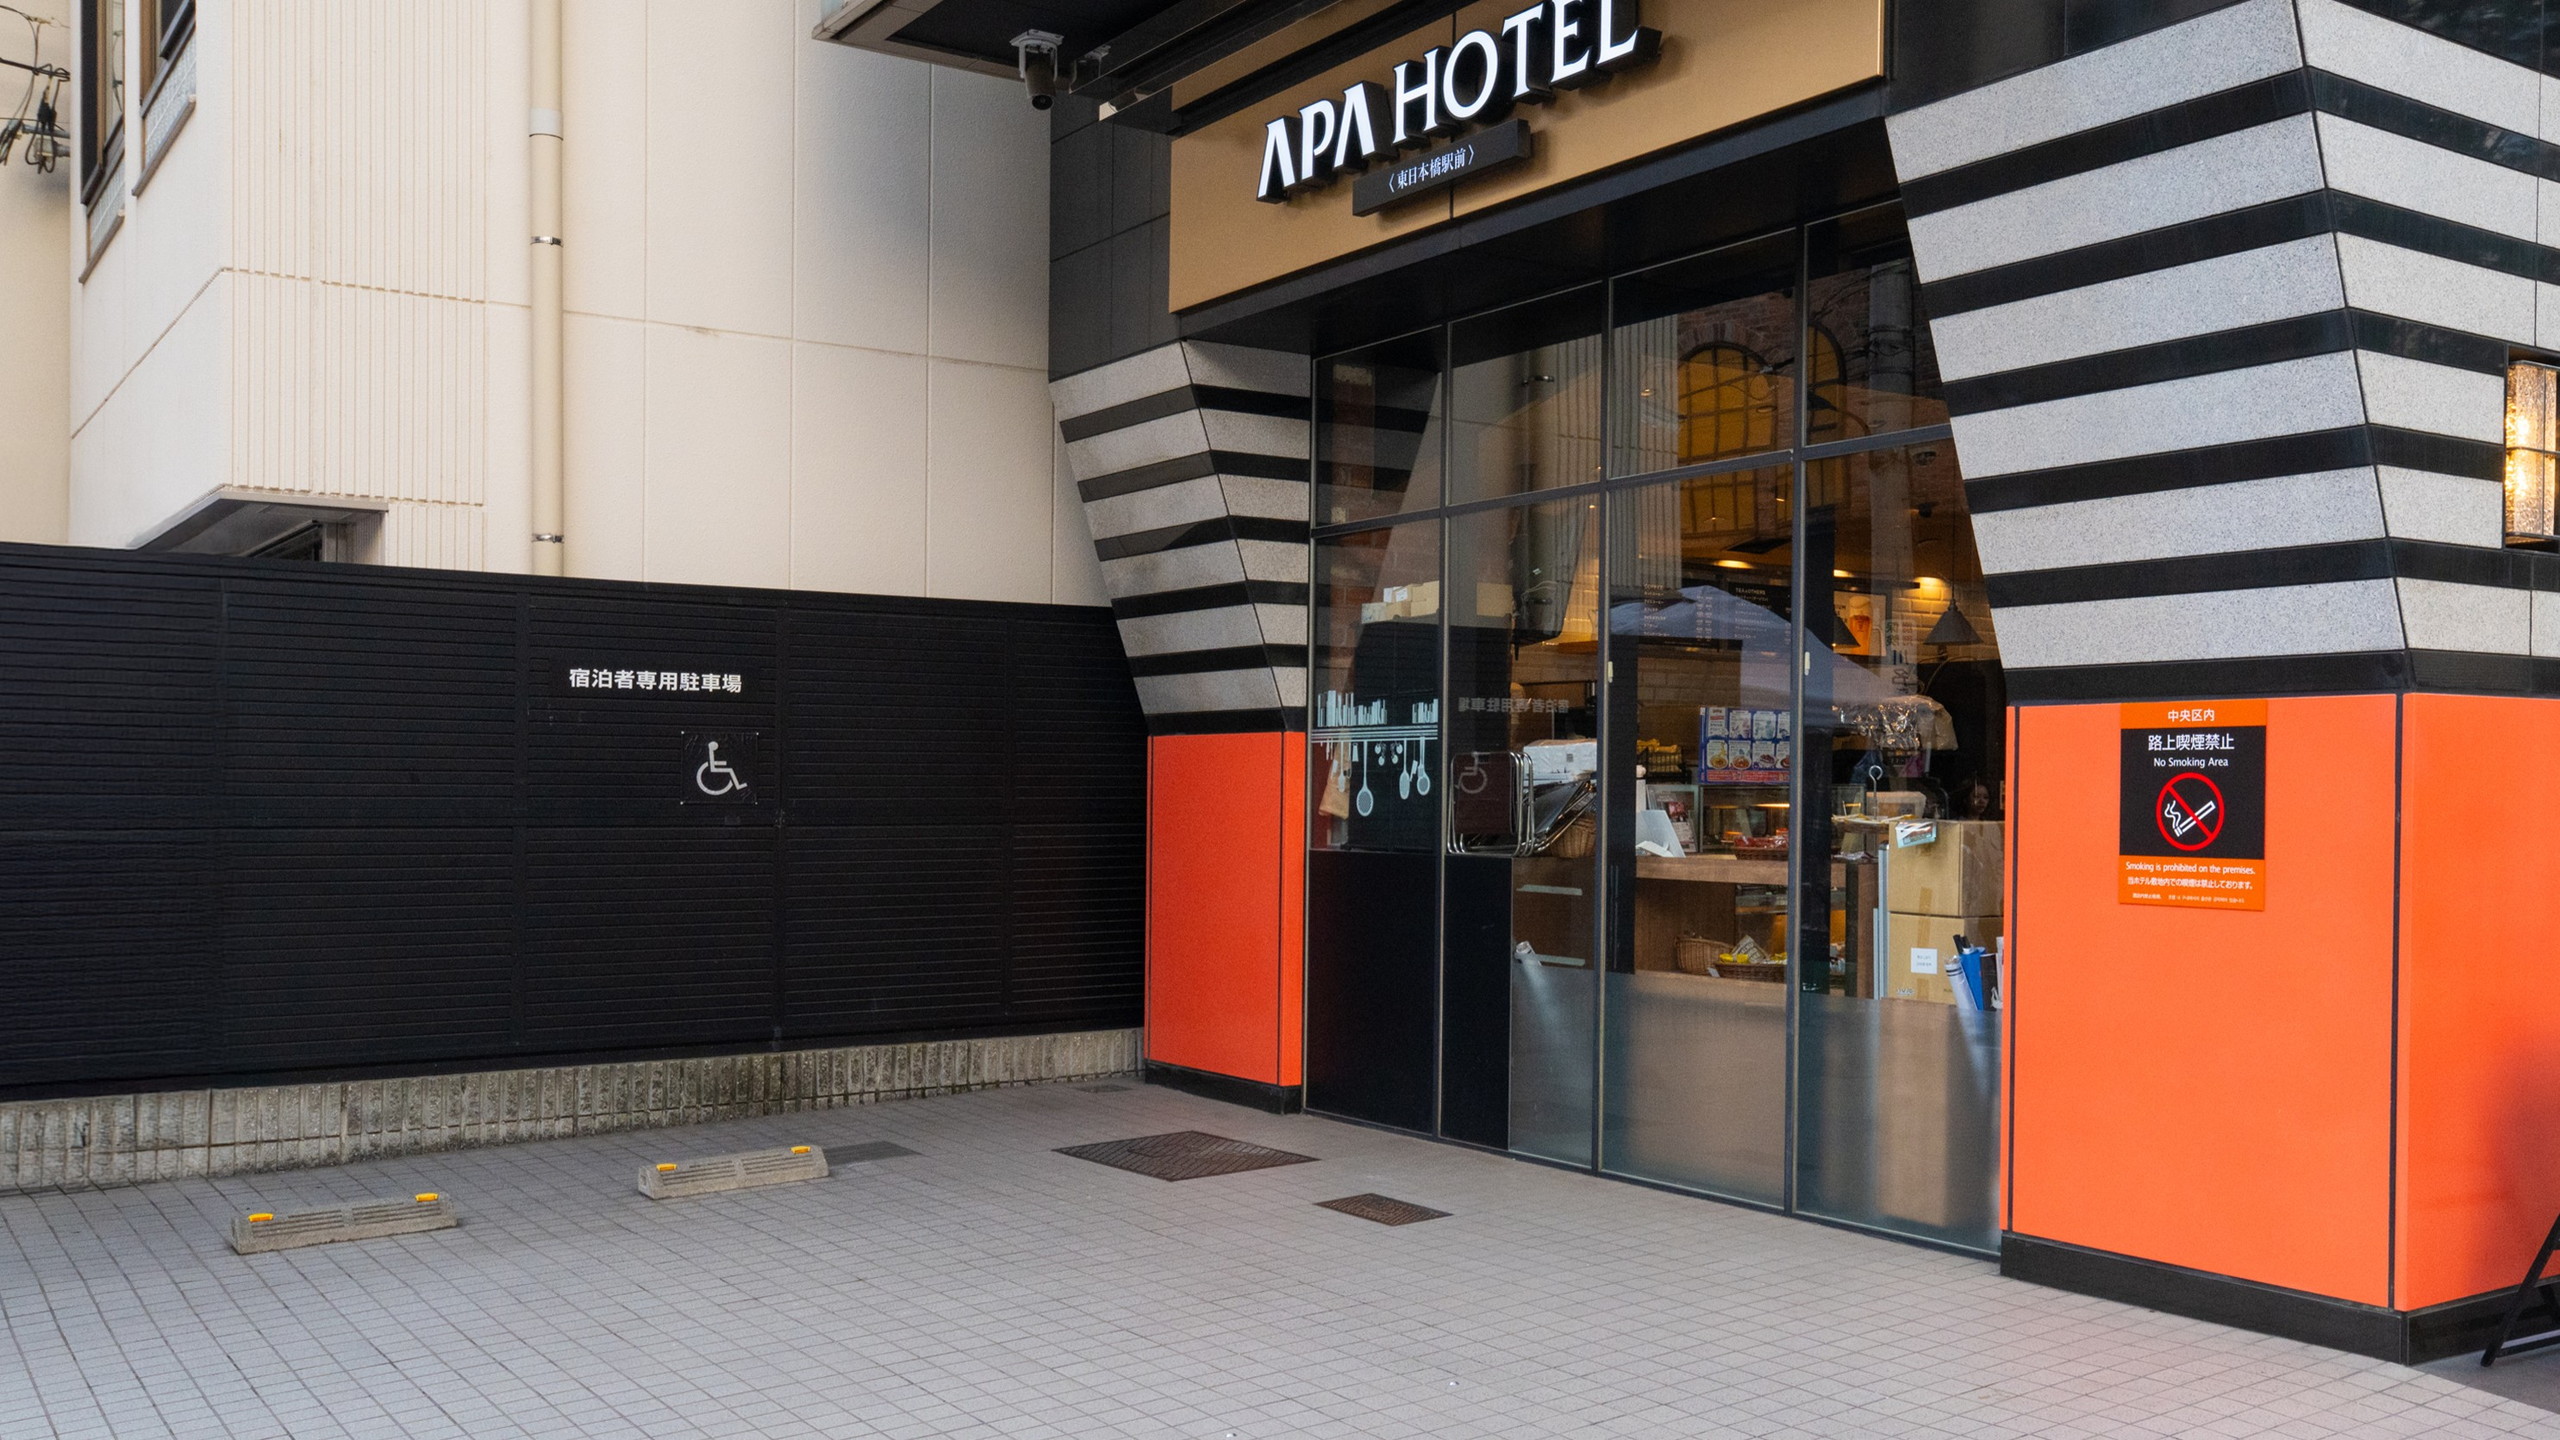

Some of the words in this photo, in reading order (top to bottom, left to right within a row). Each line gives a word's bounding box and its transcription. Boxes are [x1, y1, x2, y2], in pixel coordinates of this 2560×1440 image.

[1257, 82, 1375, 199] APA
[1392, 0, 1639, 144] HOTEL
[568, 668, 742, 693] 宿泊者専用駐車場
[2167, 708, 2215, 722] 中央区内
[2147, 733, 2235, 752] 路上喫煙禁止
[2153, 757, 2166, 767] No
[2168, 757, 2206, 769] Smoking
[2207, 757, 2229, 767] Area
[2126, 861, 2154, 872] Smoking
[2156, 862, 2161, 871] is
[2163, 863, 2197, 873] prohibited
[2209, 864, 2221, 873] the
[2222, 866, 2256, 875] premises.
